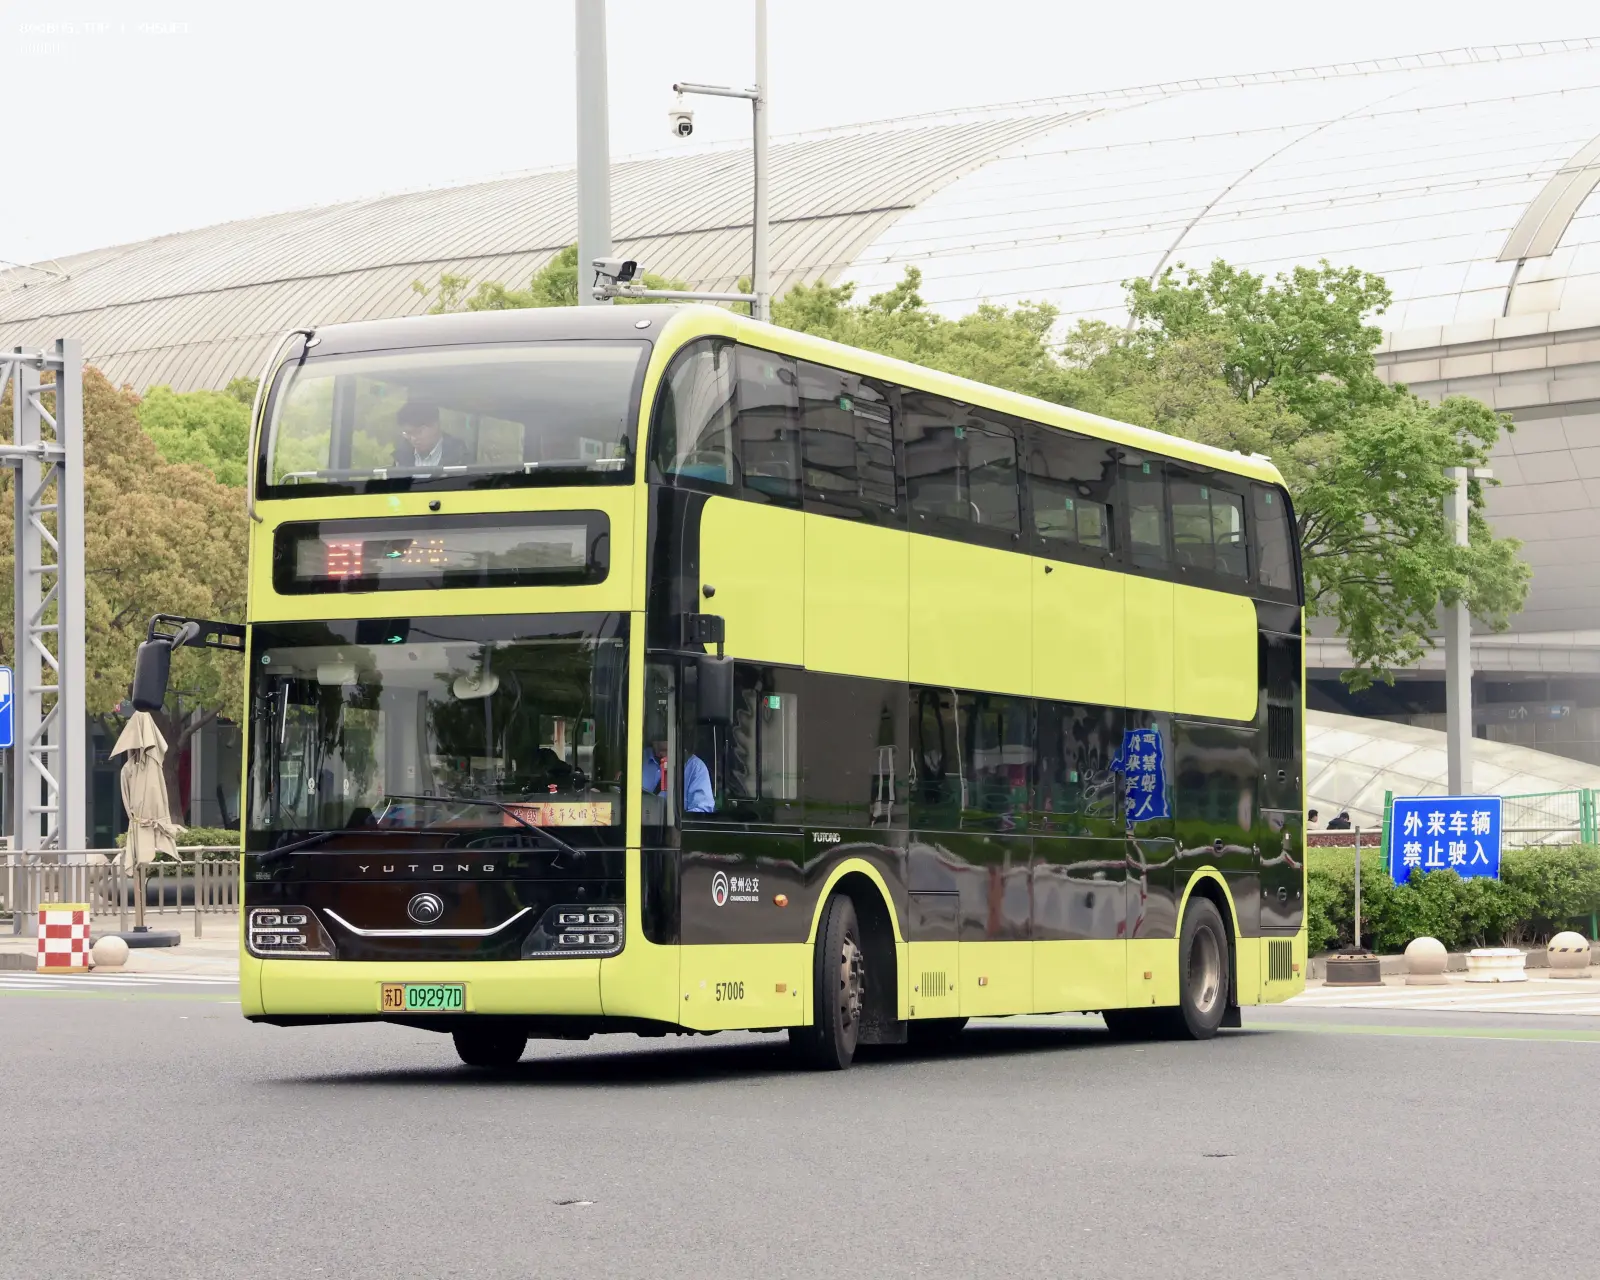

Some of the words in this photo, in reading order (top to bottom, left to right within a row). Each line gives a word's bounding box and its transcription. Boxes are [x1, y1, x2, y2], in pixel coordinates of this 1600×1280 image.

[1403, 810, 1491, 837] 外来车辆
[812, 832, 841, 843] YUTONG
[1402, 840, 1489, 867] 禁止驶入
[359, 864, 495, 873] YUTONG
[730, 876, 759, 893] 常州公交
[385, 988, 402, 1006] 苏D
[409, 988, 461, 1006] 09297D
[716, 981, 744, 1001] 57006
